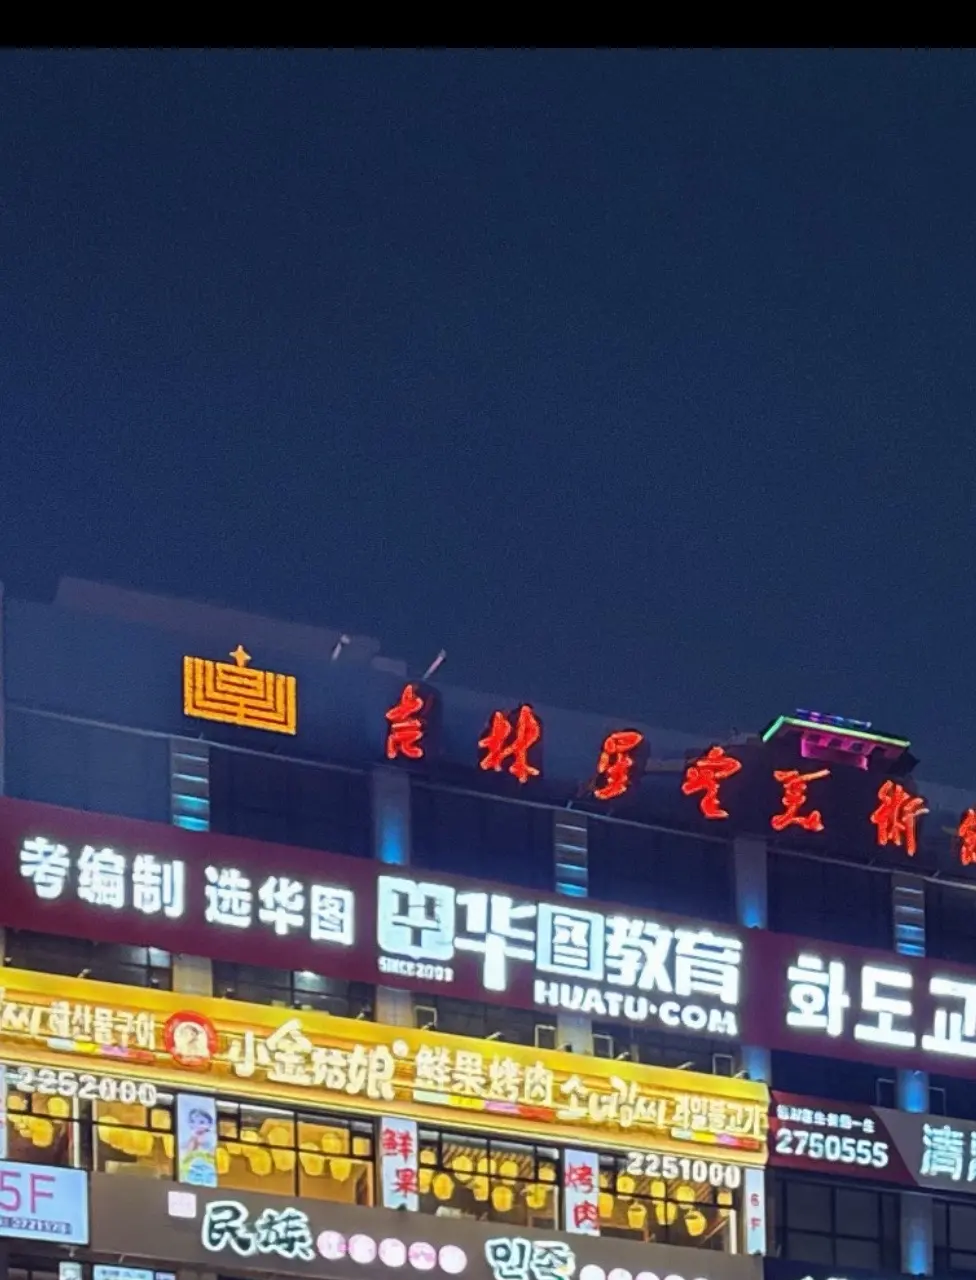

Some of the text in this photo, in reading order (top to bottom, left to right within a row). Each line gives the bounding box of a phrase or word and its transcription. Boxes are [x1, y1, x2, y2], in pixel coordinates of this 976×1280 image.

[21, 837, 356, 947] 考编制 选华图
[454, 889, 742, 1007] 华图教育
[415, 1043, 554, 1106] 鲜果烤肉
[626, 1152, 741, 1189] 2251000
[775, 1127, 888, 1169] 2750555
[201, 1200, 316, 1262] 民族
